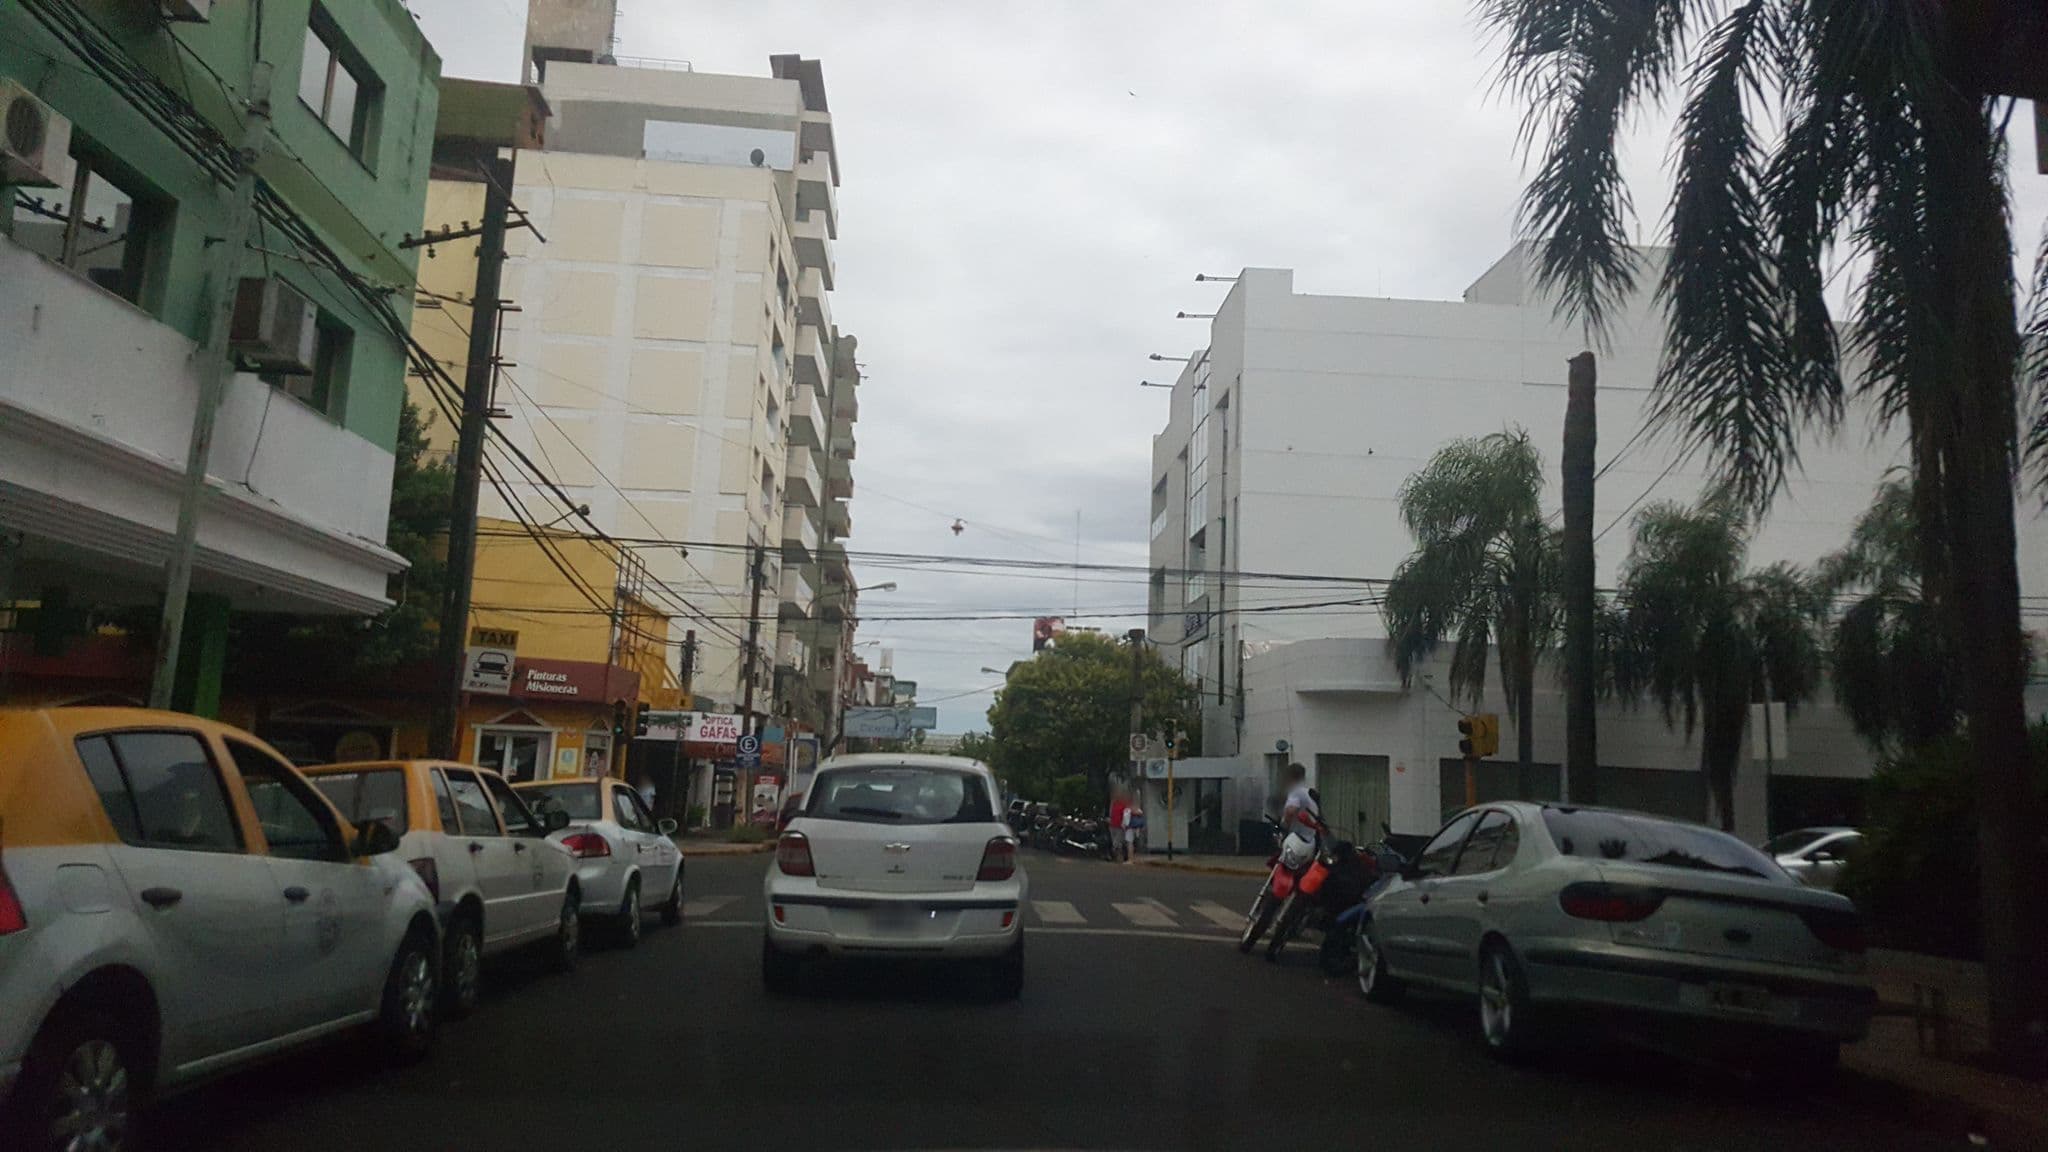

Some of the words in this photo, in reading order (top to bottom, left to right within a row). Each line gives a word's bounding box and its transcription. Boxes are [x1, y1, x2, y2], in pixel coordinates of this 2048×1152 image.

[478, 630, 516, 645] TAXI
[527, 669, 568, 682] Pinturas
[526, 681, 578, 695] Misioneras
[700, 726, 737, 739] GAFAS
[744, 739, 753, 751] E
